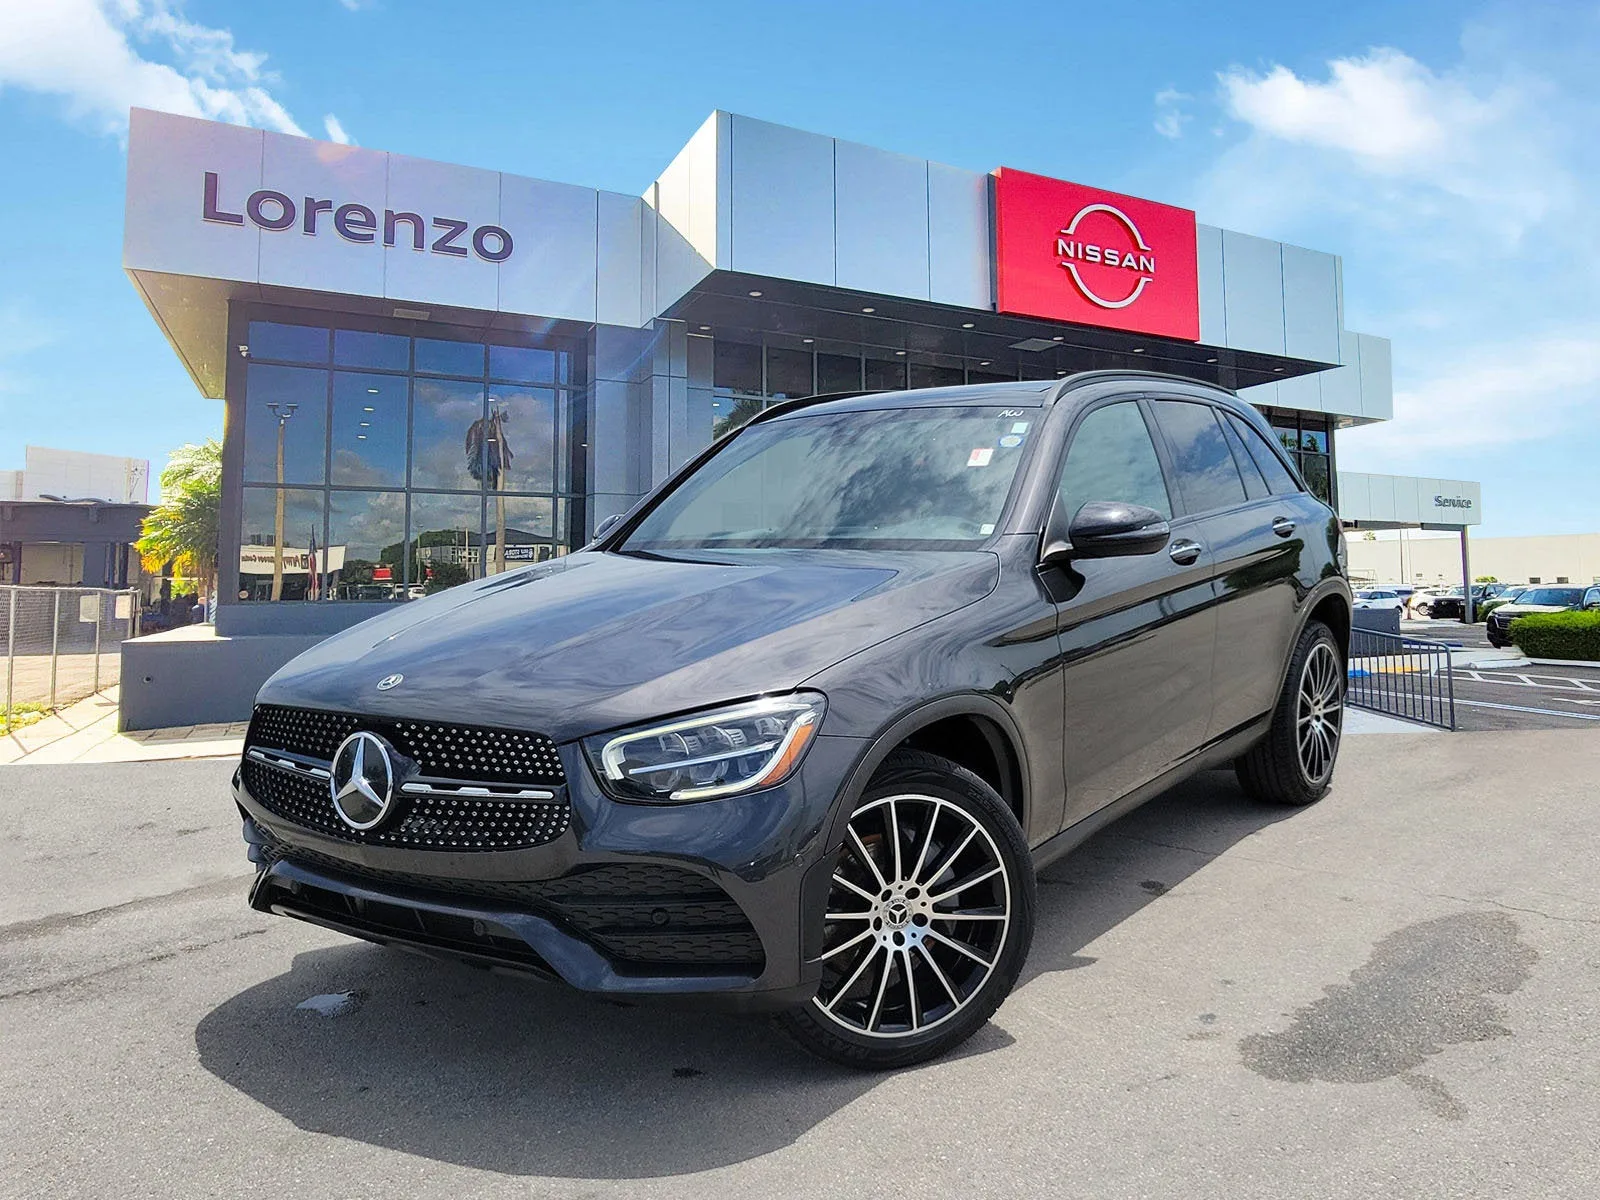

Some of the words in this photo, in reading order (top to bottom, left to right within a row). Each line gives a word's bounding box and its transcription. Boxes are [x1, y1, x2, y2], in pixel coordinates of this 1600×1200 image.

[202, 171, 515, 263] Lorenzo
[1057, 238, 1155, 273] NISSAN
[1434, 495, 1472, 509] Service
